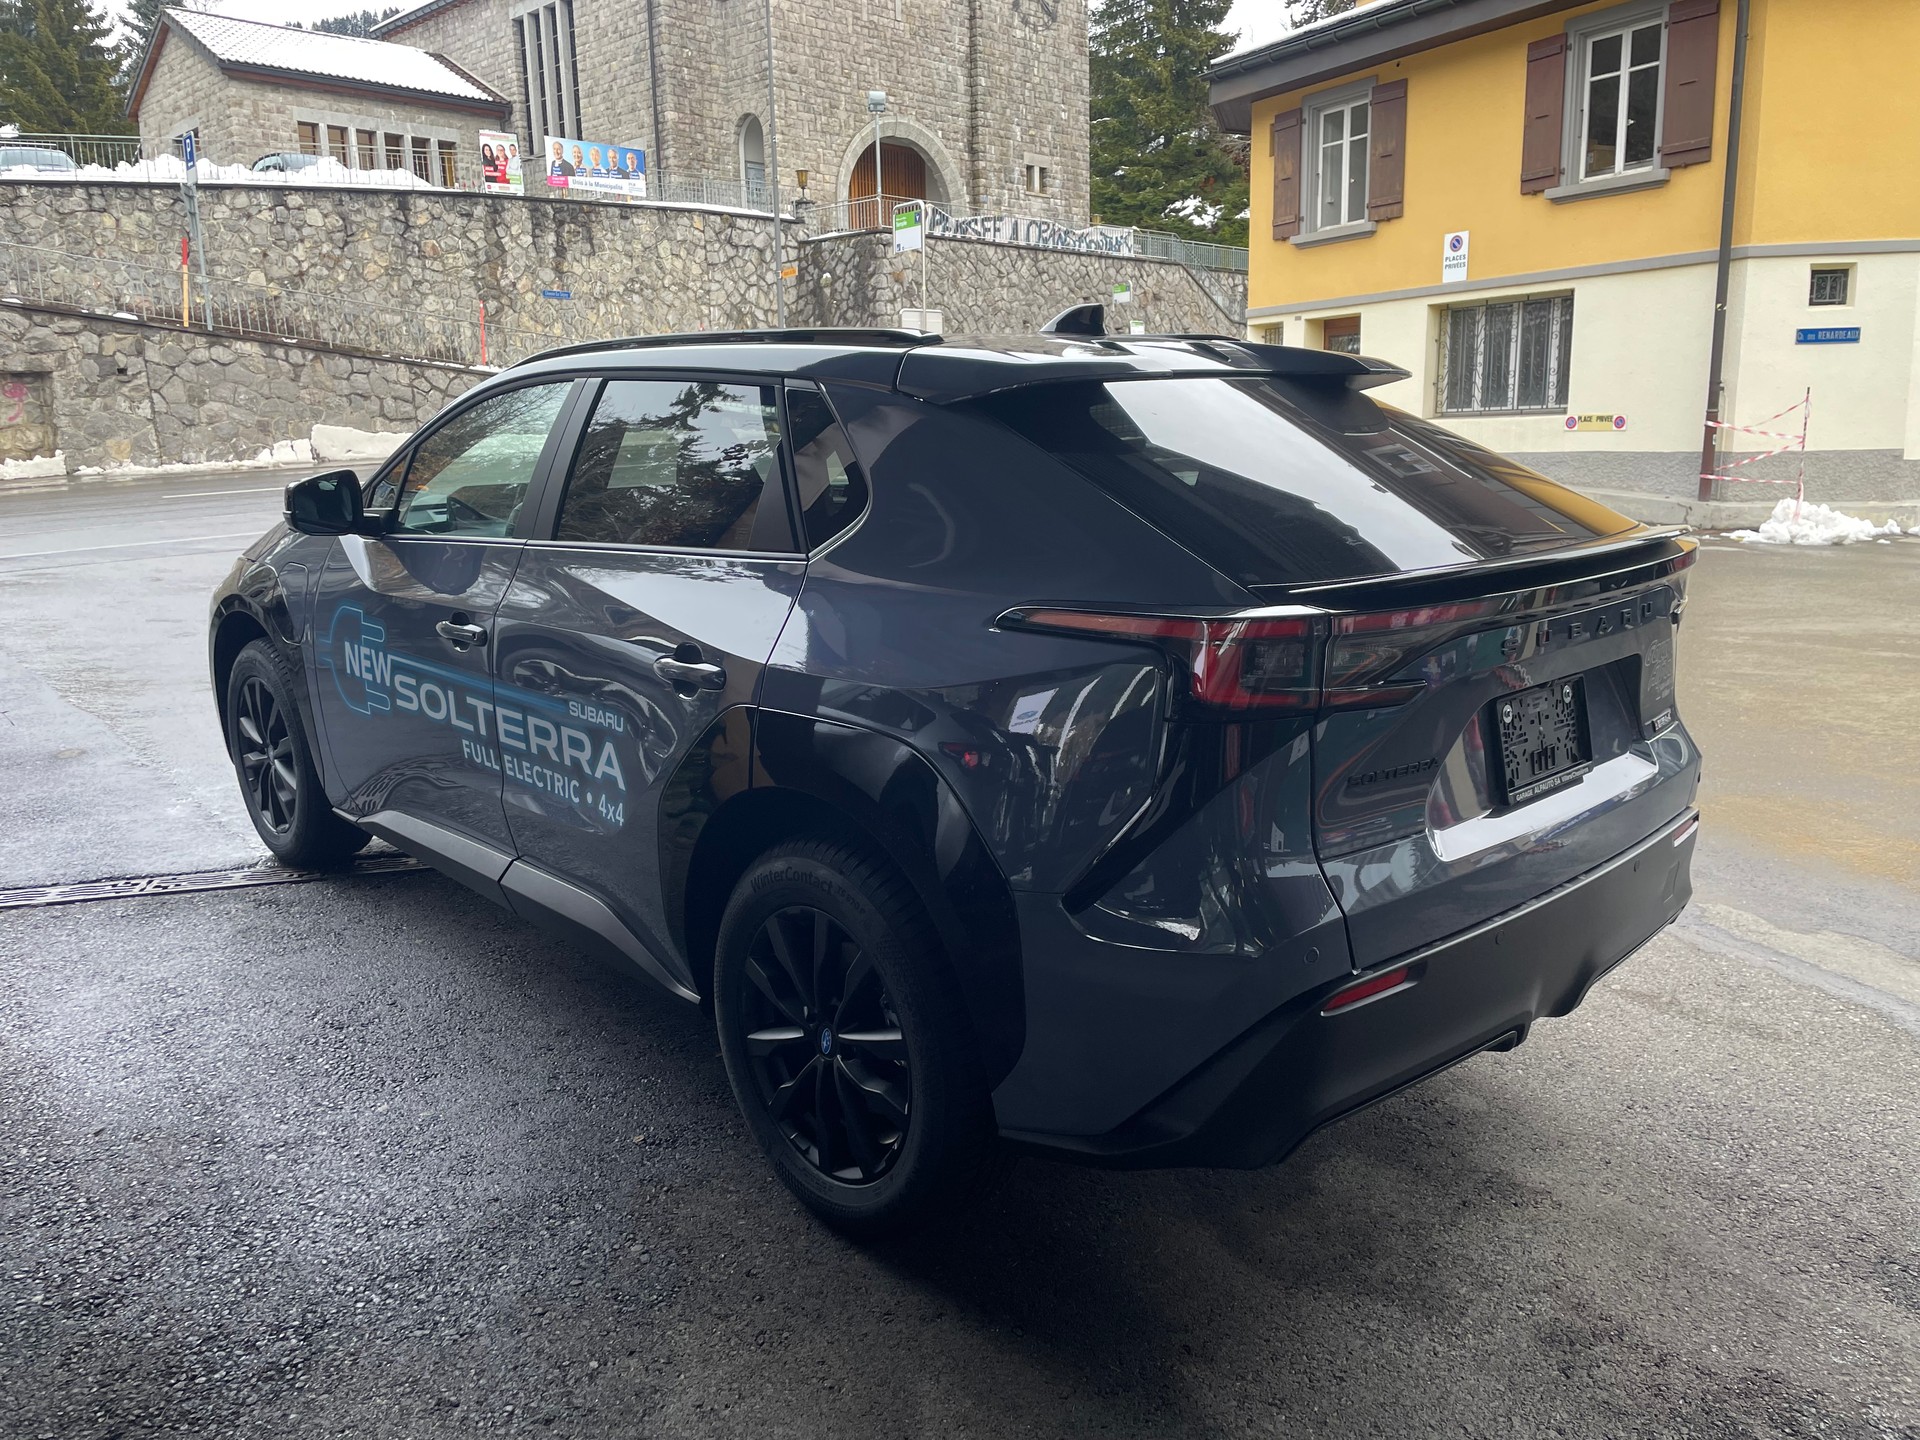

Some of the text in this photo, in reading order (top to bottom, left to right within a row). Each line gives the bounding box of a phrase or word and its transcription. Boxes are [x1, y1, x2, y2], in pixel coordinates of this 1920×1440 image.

[185, 138, 191, 160] P
[572, 178, 584, 186] Unis
[594, 180, 623, 191] Municipalité
[1445, 254, 1466, 262] PLACES
[1817, 330, 1860, 340] RENARDEAUX
[1578, 415, 1593, 423] PLACE
[1501, 601, 1652, 653] SUBARU
[345, 641, 391, 687] NEW
[568, 701, 625, 732] SUBARU
[394, 674, 626, 791] SOLTERRA
[461, 738, 625, 827] FULL ELECTRIC 4x4
[1347, 757, 1440, 787] SOLTERRA
[1515, 777, 1561, 802] GARAGE ALPAUTO SA
[750, 866, 834, 896] WinterContact
